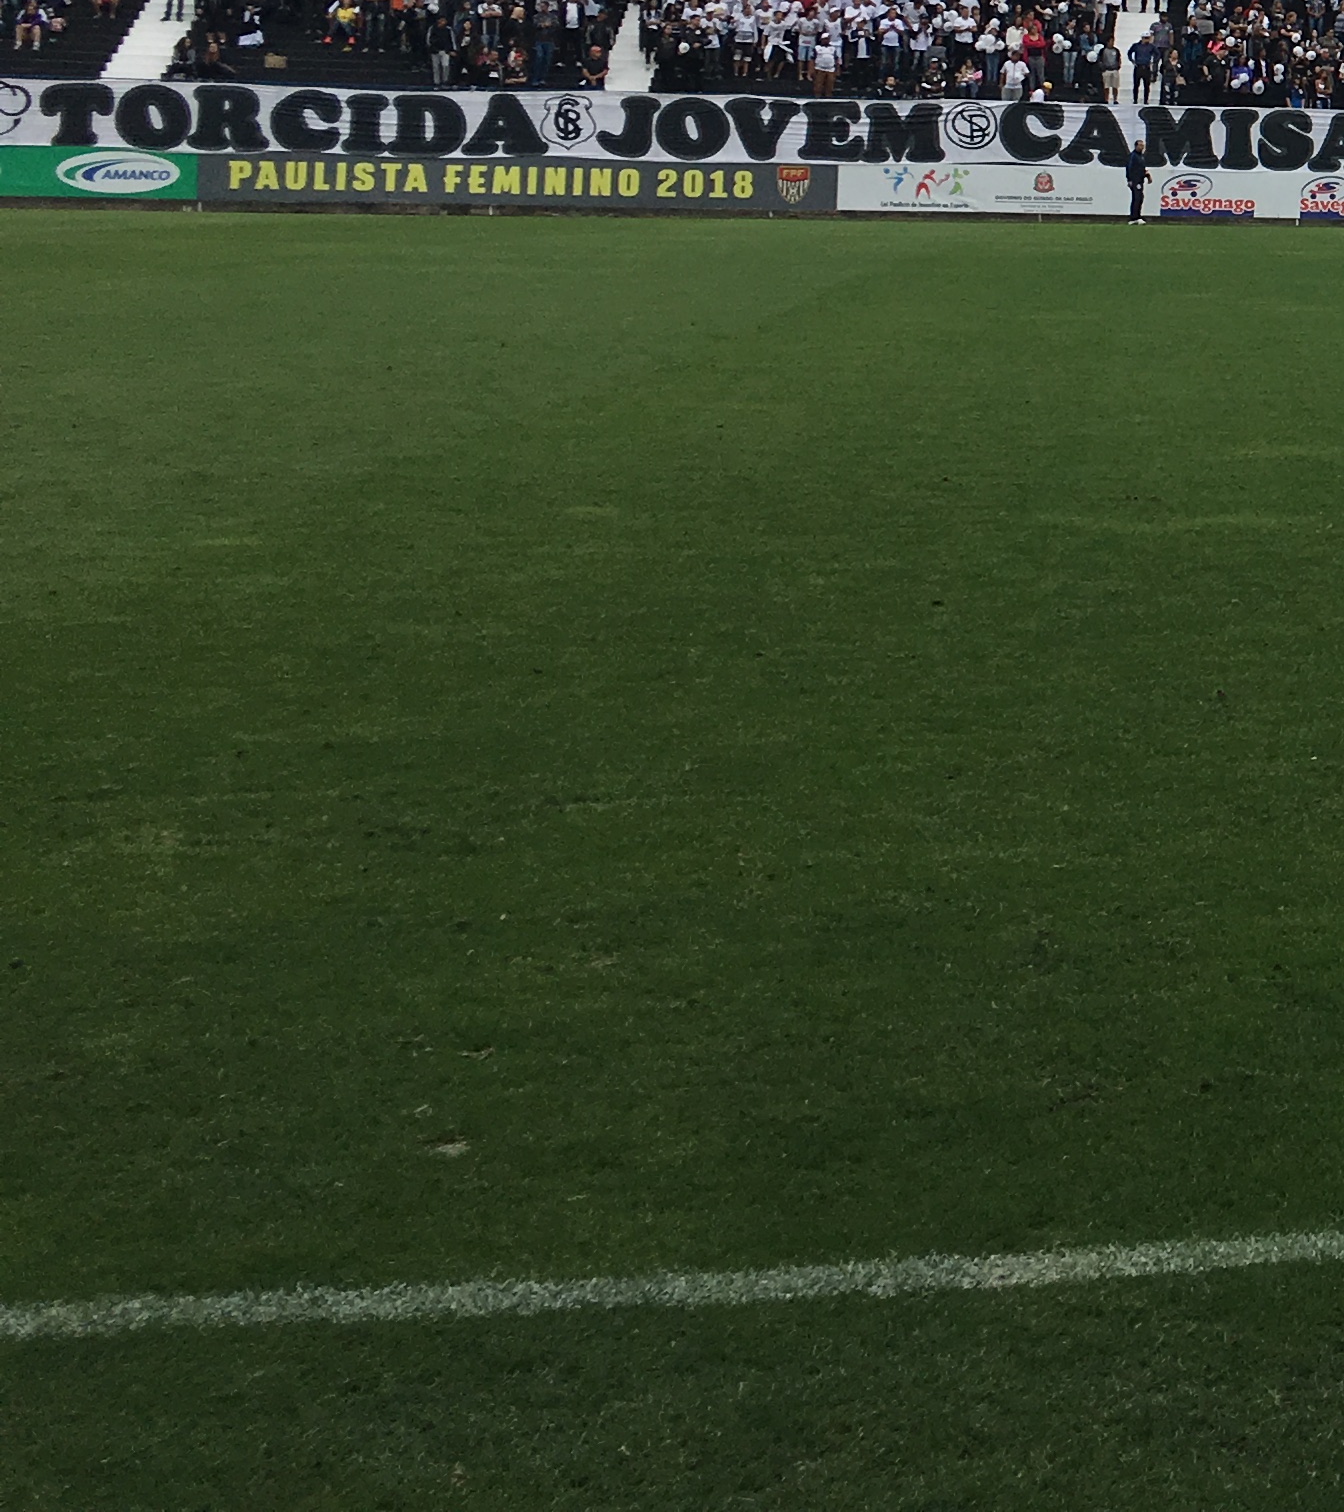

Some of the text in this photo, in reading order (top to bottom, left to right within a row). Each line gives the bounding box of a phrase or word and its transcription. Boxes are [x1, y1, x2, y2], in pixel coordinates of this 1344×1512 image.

[39, 83, 549, 157] TORCIDA
[596, 96, 946, 163] JOVEM
[102, 169, 171, 182] AMANCO
[228, 161, 753, 198] PAULISTA FEMININO 2018
[1160, 195, 1255, 215] Savegnago
